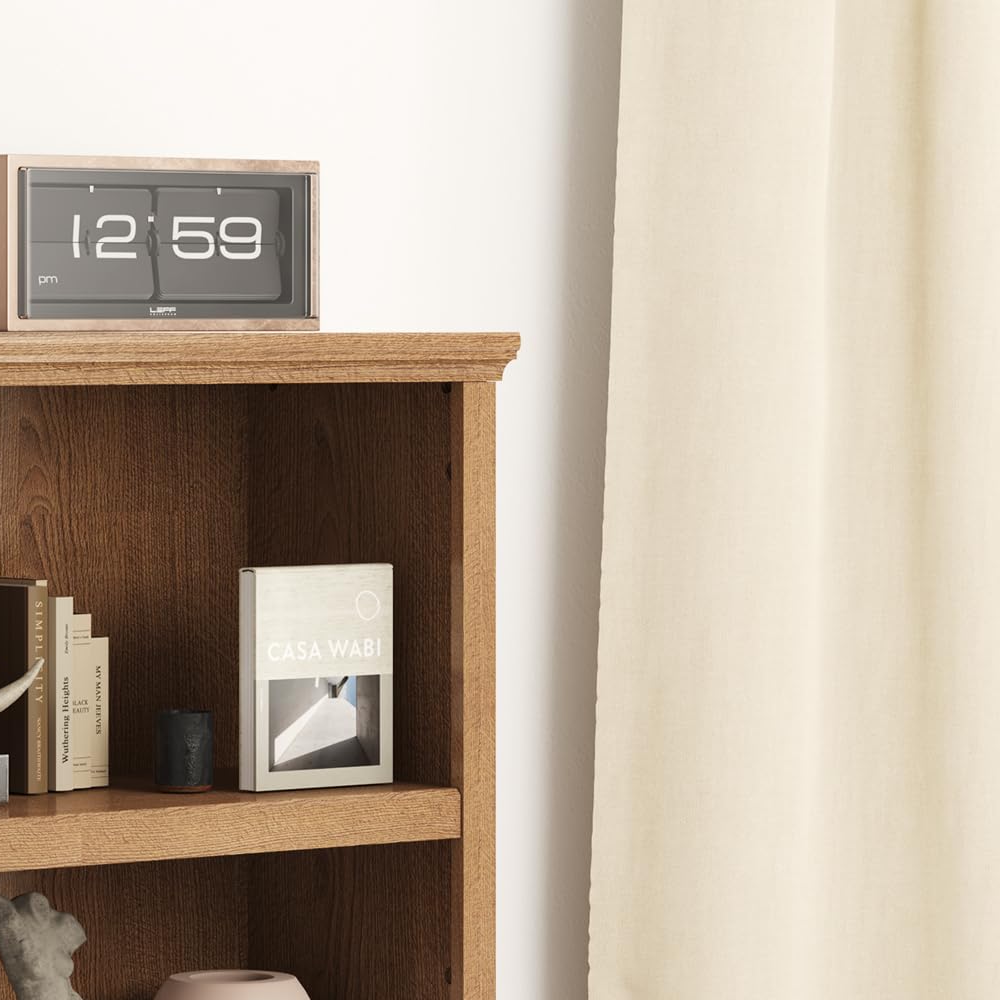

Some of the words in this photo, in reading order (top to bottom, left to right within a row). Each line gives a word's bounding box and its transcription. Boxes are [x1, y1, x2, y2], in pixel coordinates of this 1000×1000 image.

[38, 274, 58, 286] pm
[267, 641, 322, 662] CASA
[328, 637, 382, 658] WABI
[95, 665, 102, 680] MY
[62, 715, 70, 764] Wuthering
